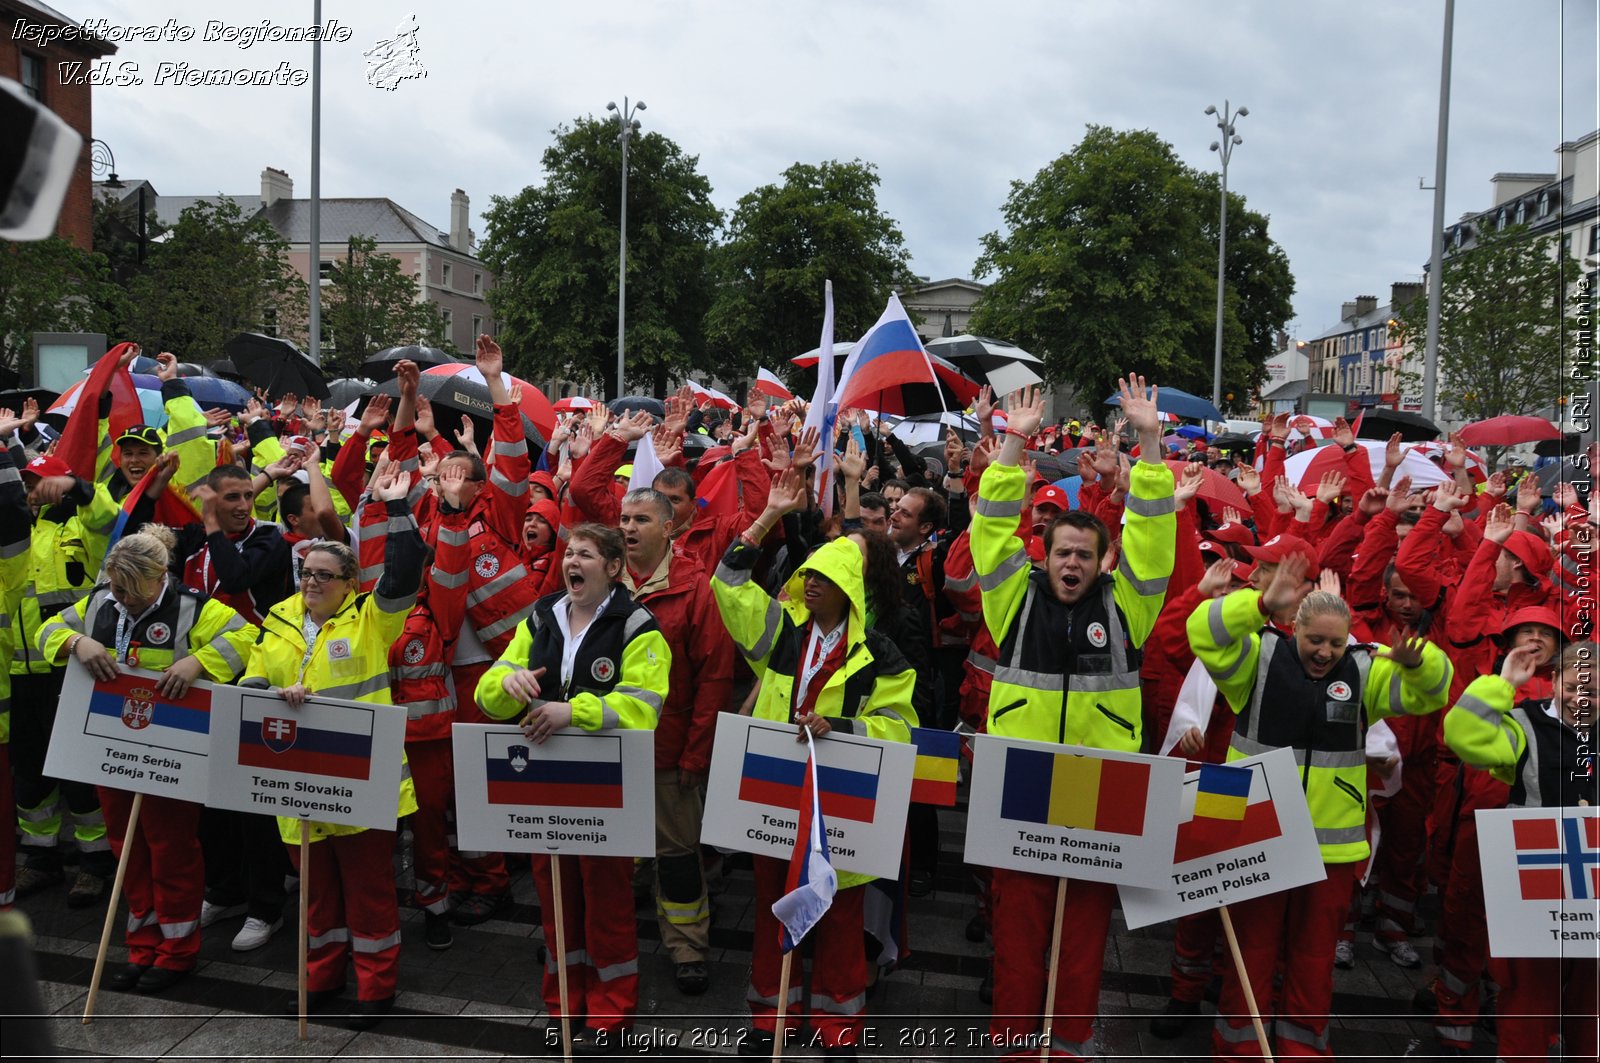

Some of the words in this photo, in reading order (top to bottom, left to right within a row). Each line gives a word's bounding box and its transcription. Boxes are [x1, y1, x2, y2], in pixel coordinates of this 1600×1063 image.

[105, 747, 138, 764] Team
[142, 754, 182, 770] Serbia
[101, 762, 144, 780] Србија
[252, 776, 290, 792] Team
[293, 780, 353, 798] Slovakia
[250, 791, 277, 806] Tím
[280, 795, 352, 815] Slovensko
[508, 814, 544, 825] Team
[548, 815, 604, 827] Slovenia
[762, 815, 797, 830] Team
[826, 827, 845, 839] sia
[506, 829, 543, 841] Team
[546, 831, 607, 843] Slovenija
[746, 828, 795, 846] Сборна
[827, 845, 855, 858] ссии
[1018, 830, 1055, 845] Team
[1060, 836, 1121, 853] Romania
[1012, 846, 1057, 862] Echipa
[1062, 853, 1123, 870] România
[1172, 866, 1213, 886] Team
[1216, 851, 1267, 875] Poland
[1177, 886, 1219, 903] Team
[1222, 871, 1270, 892] Polska
[1548, 910, 1594, 922] Team
